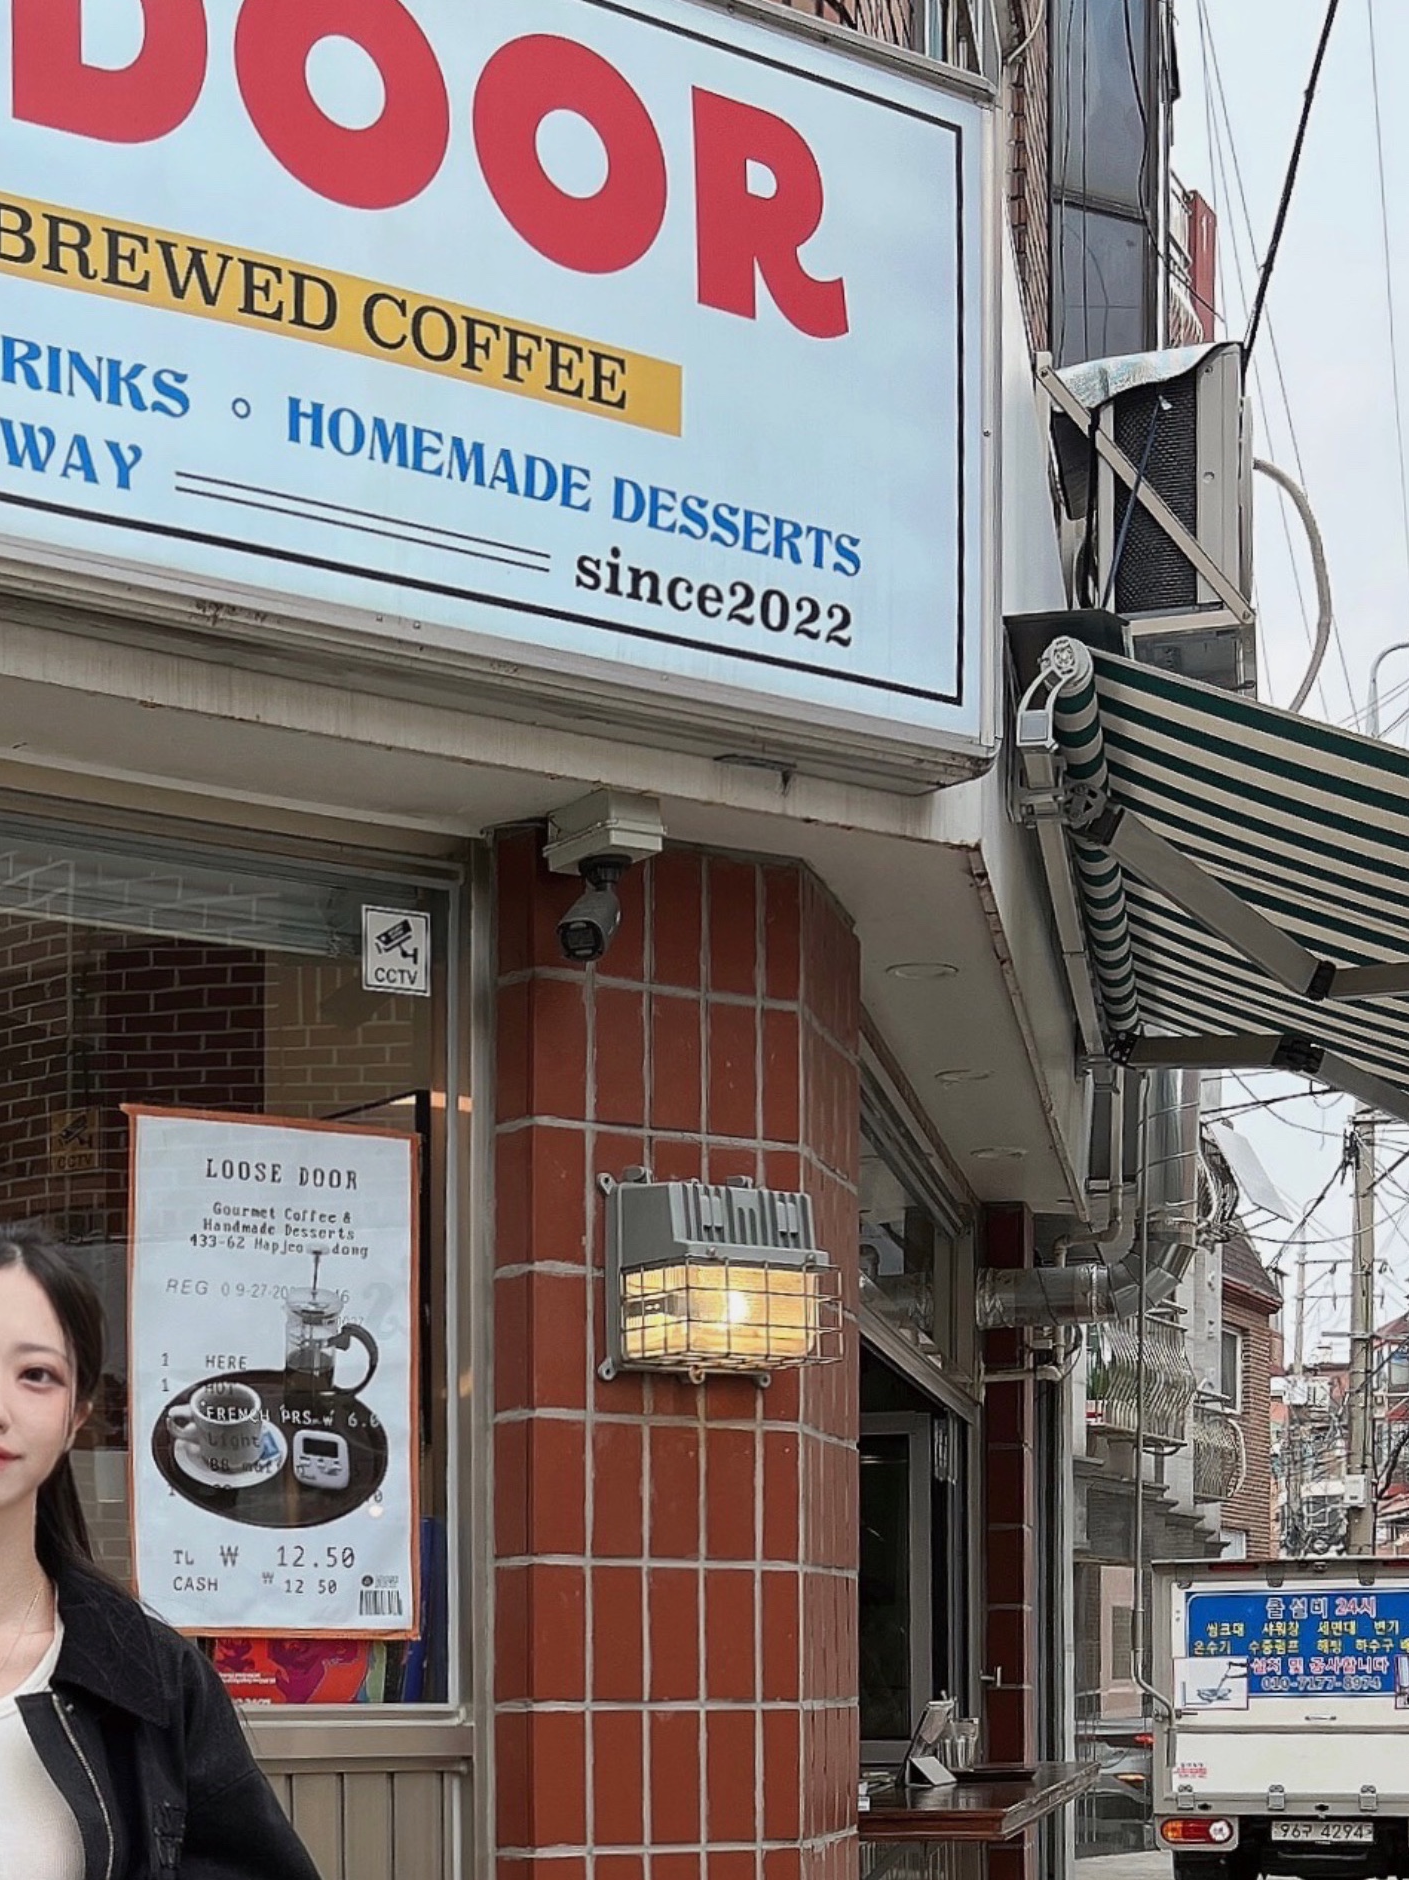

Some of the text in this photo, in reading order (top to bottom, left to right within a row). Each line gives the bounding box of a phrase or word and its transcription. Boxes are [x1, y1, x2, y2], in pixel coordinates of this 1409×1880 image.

[362, 292, 629, 411] COFFEE
[287, 395, 593, 514] HOMEMADE
[611, 476, 862, 578] DESSERTS
[574, 545, 855, 650] since2022
[375, 967, 418, 985] CCTV
[205, 1157, 358, 1191] LOOSE DOOR
[212, 1201, 352, 1225] Gourmet Coffee &
[202, 1218, 356, 1240] Handmade Desserts
[165, 1278, 209, 1296] REG
[161, 1352, 248, 1371] 1 HERE
[161, 1378, 170, 1392] 1
[206, 1405, 270, 1425] FRENCH
[172, 1550, 195, 1566] TL
[276, 1545, 355, 1569] 12.50
[172, 1576, 219, 1592] CASH
[1335, 1596, 1376, 1619] 24시
[1317, 1620, 1356, 1637] 세면대
[1374, 1620, 1399, 1636] 변기
[1193, 1640, 1231, 1655] 온수기
[1355, 1638, 1394, 1654] 하수구
[1309, 1655, 1390, 1676] 공사합니다
[1280, 1823, 1364, 1839] 96구 4294
